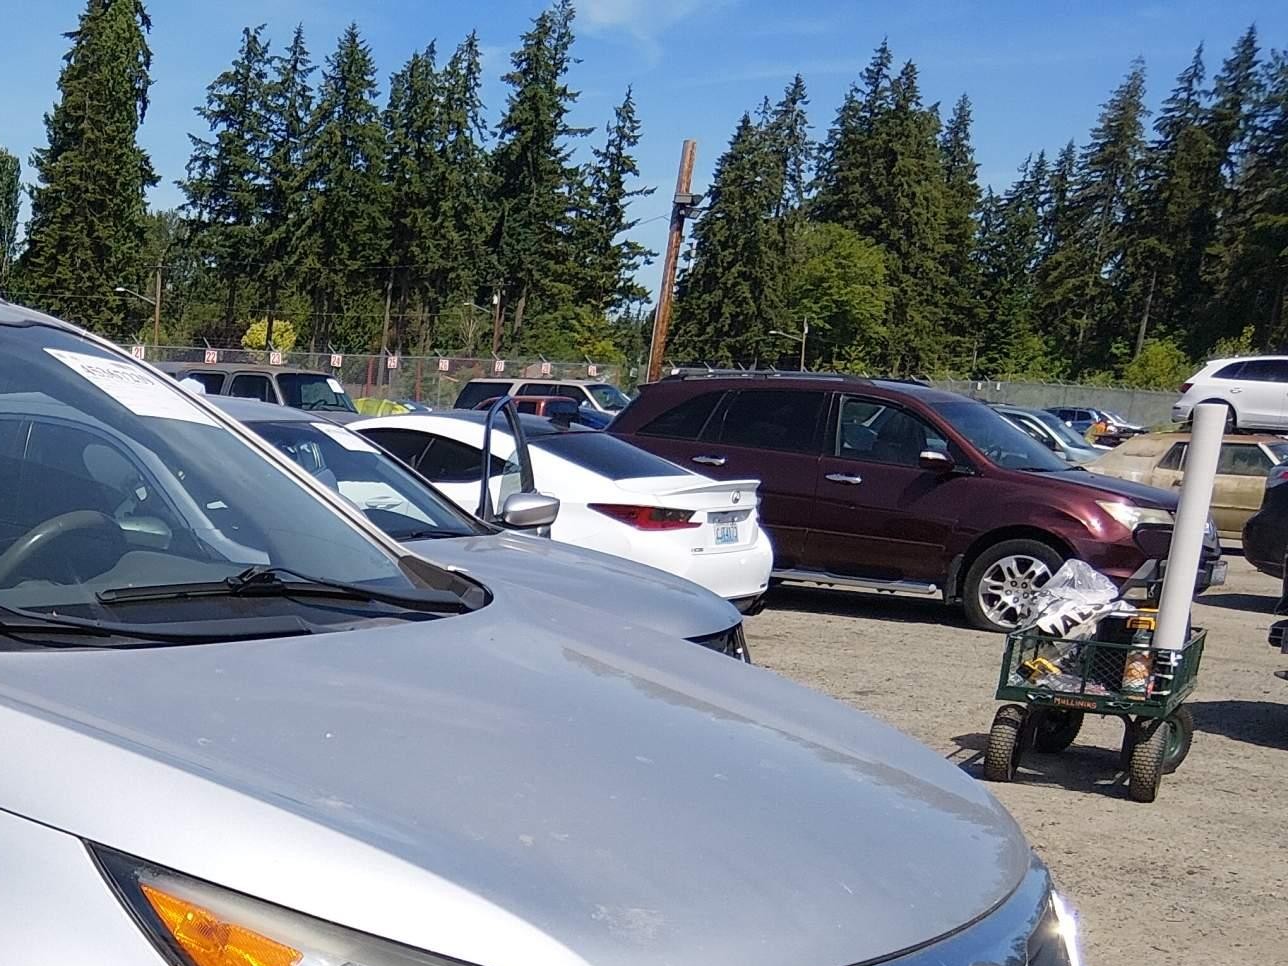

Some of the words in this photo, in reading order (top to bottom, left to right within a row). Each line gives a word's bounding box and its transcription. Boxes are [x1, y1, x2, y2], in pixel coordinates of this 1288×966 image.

[206, 351, 217, 363] 22
[271, 353, 280, 365] 23
[331, 355, 341, 367] 24
[388, 358, 397, 369] 25
